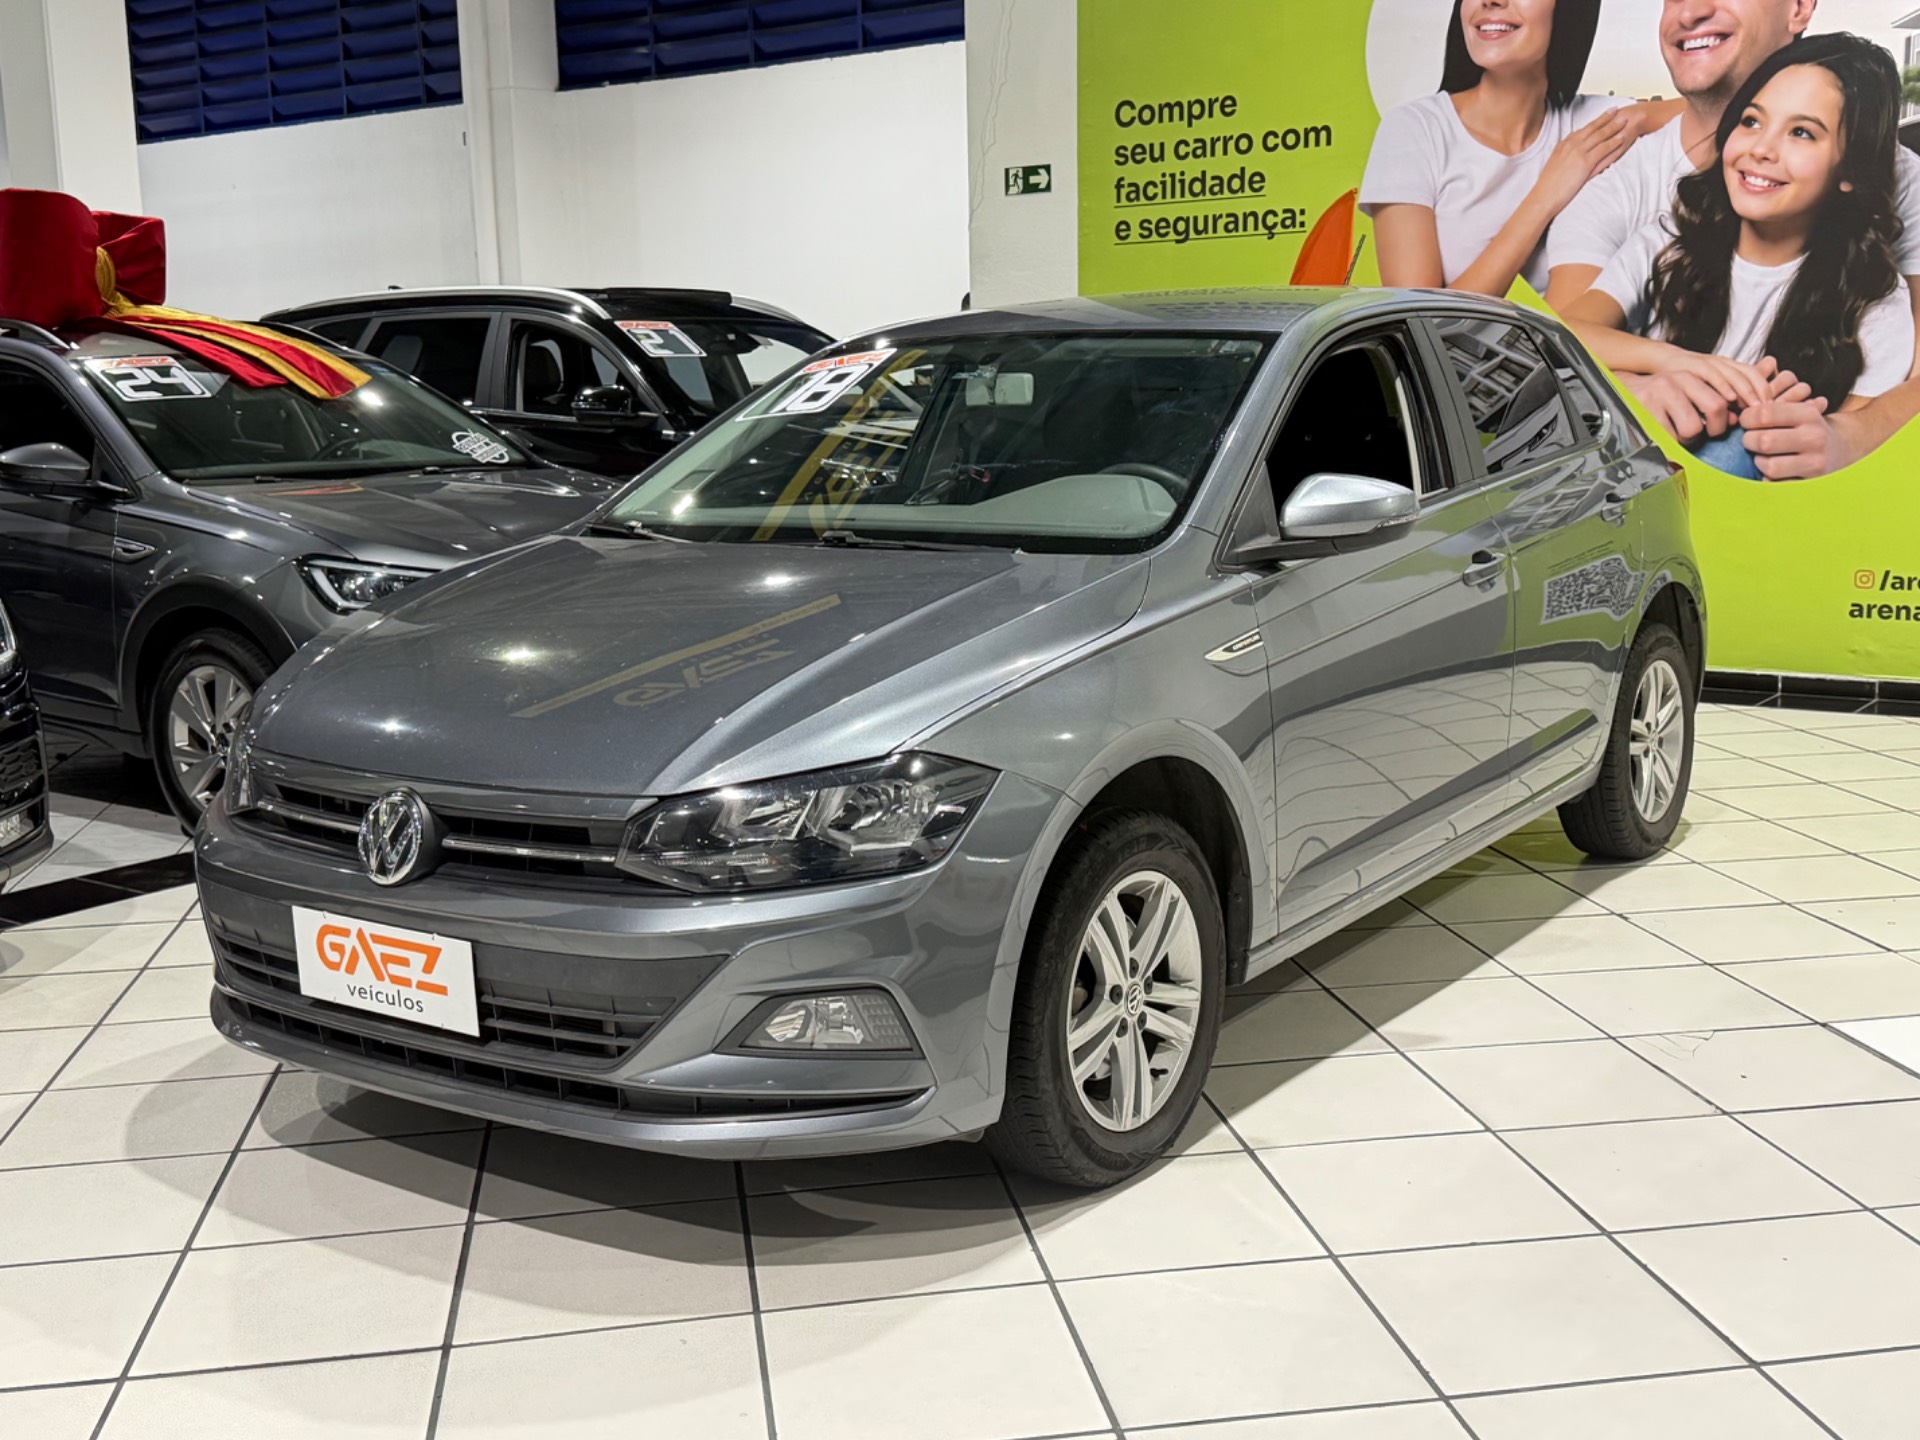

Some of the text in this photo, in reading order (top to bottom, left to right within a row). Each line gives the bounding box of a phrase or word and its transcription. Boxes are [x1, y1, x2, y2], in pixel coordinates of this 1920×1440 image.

[1114, 94, 1238, 129] Compre
[1114, 124, 1332, 166] seu carro com
[1114, 166, 1266, 204] facilidade
[1115, 207, 1307, 244] e segurança:
[627, 328, 701, 355] 21
[101, 366, 203, 397] 24
[768, 363, 871, 413] 18
[1879, 569, 1920, 591] /ar
[315, 923, 449, 997] GAEZ
